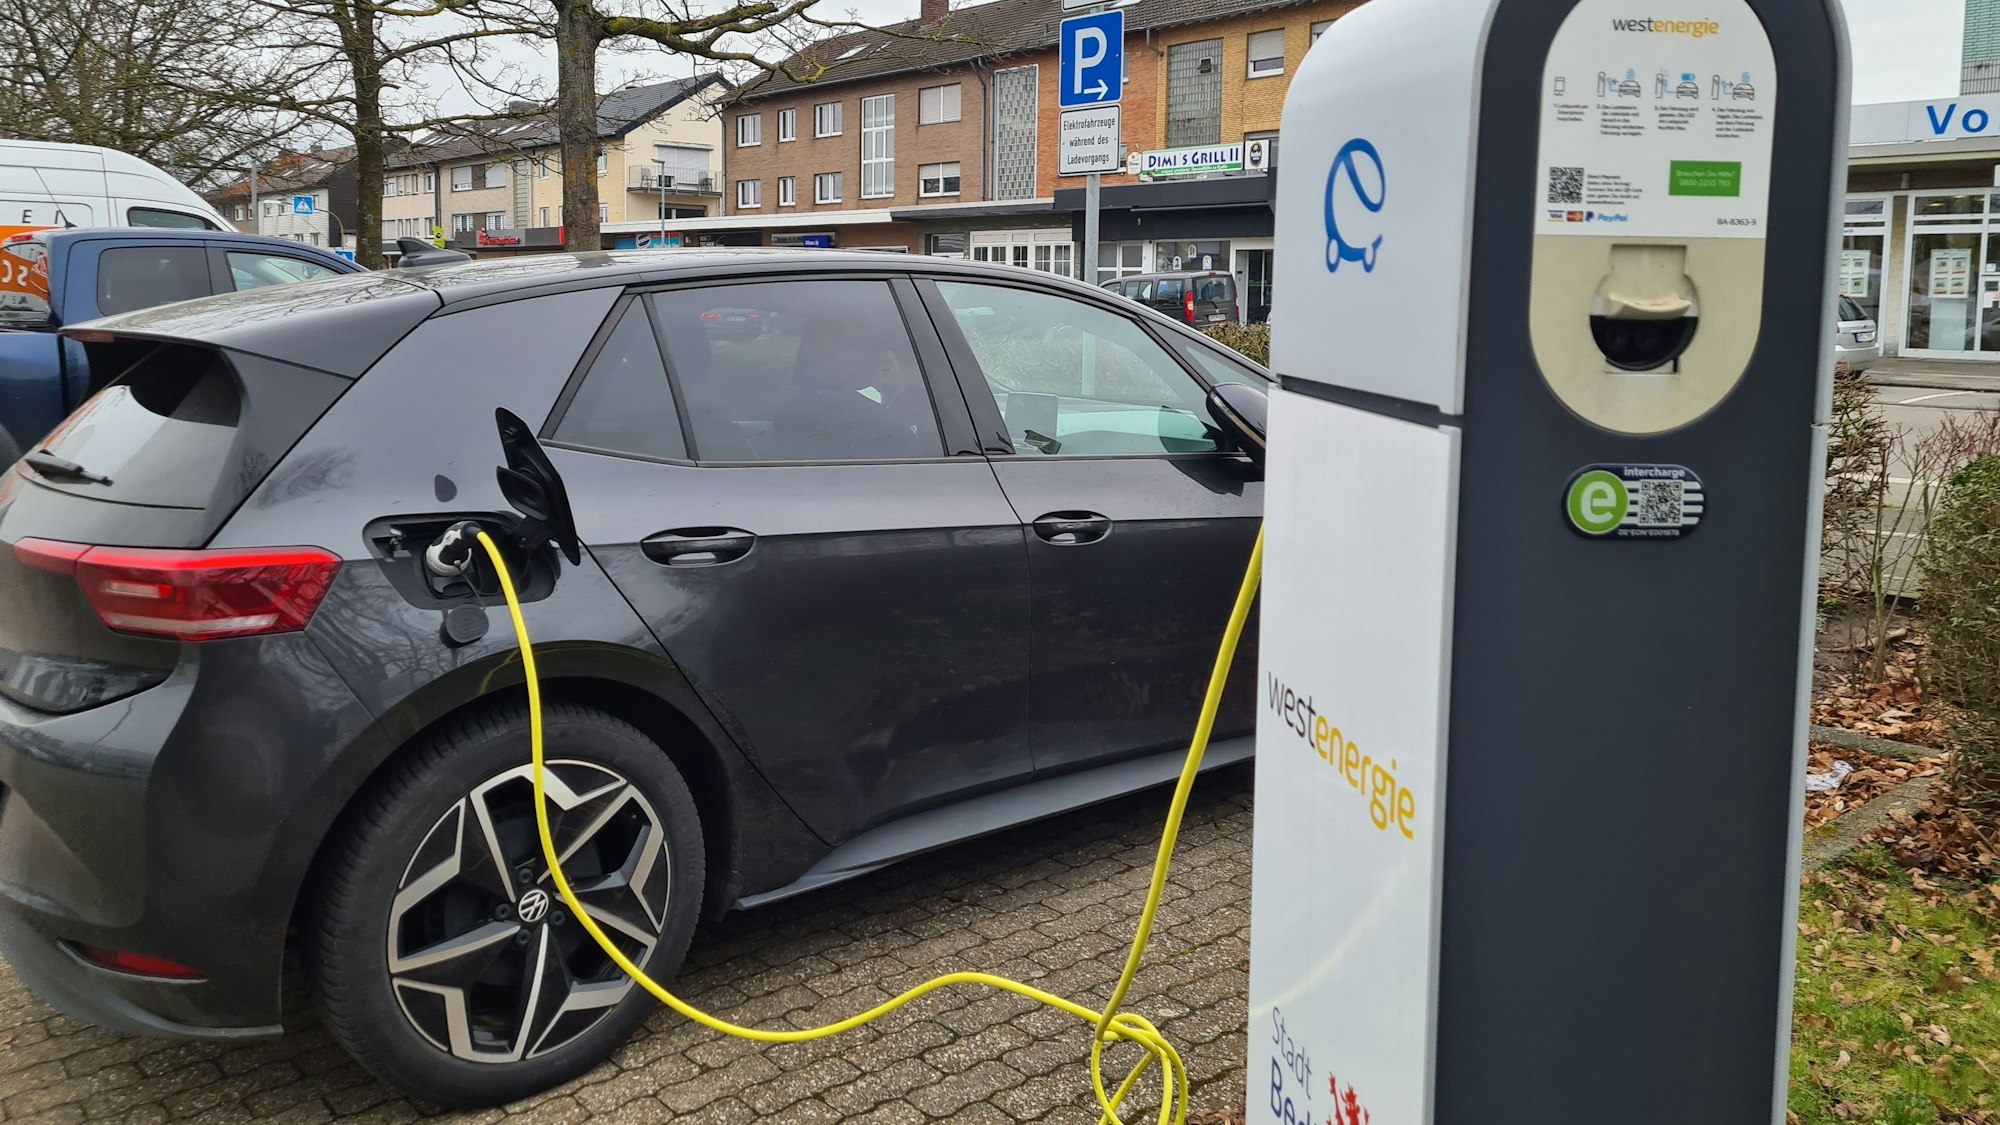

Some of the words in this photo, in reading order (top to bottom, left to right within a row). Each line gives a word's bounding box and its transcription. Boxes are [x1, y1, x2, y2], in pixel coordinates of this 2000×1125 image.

[1613, 17, 1719, 38] westenergie
[1074, 27, 1107, 94] P
[1063, 117, 1116, 131] Elektrofahrzeuge
[1069, 135, 1095, 147] während
[1097, 134, 1109, 145] des
[1067, 153, 1110, 165] Ladevorgangs
[1191, 151, 1226, 164] GRILL
[1598, 213, 1628, 222] PayPal
[1624, 466, 1686, 479] intercharge
[1268, 671, 1416, 840] westenergie
[1272, 1006, 1312, 1101] Stadt
